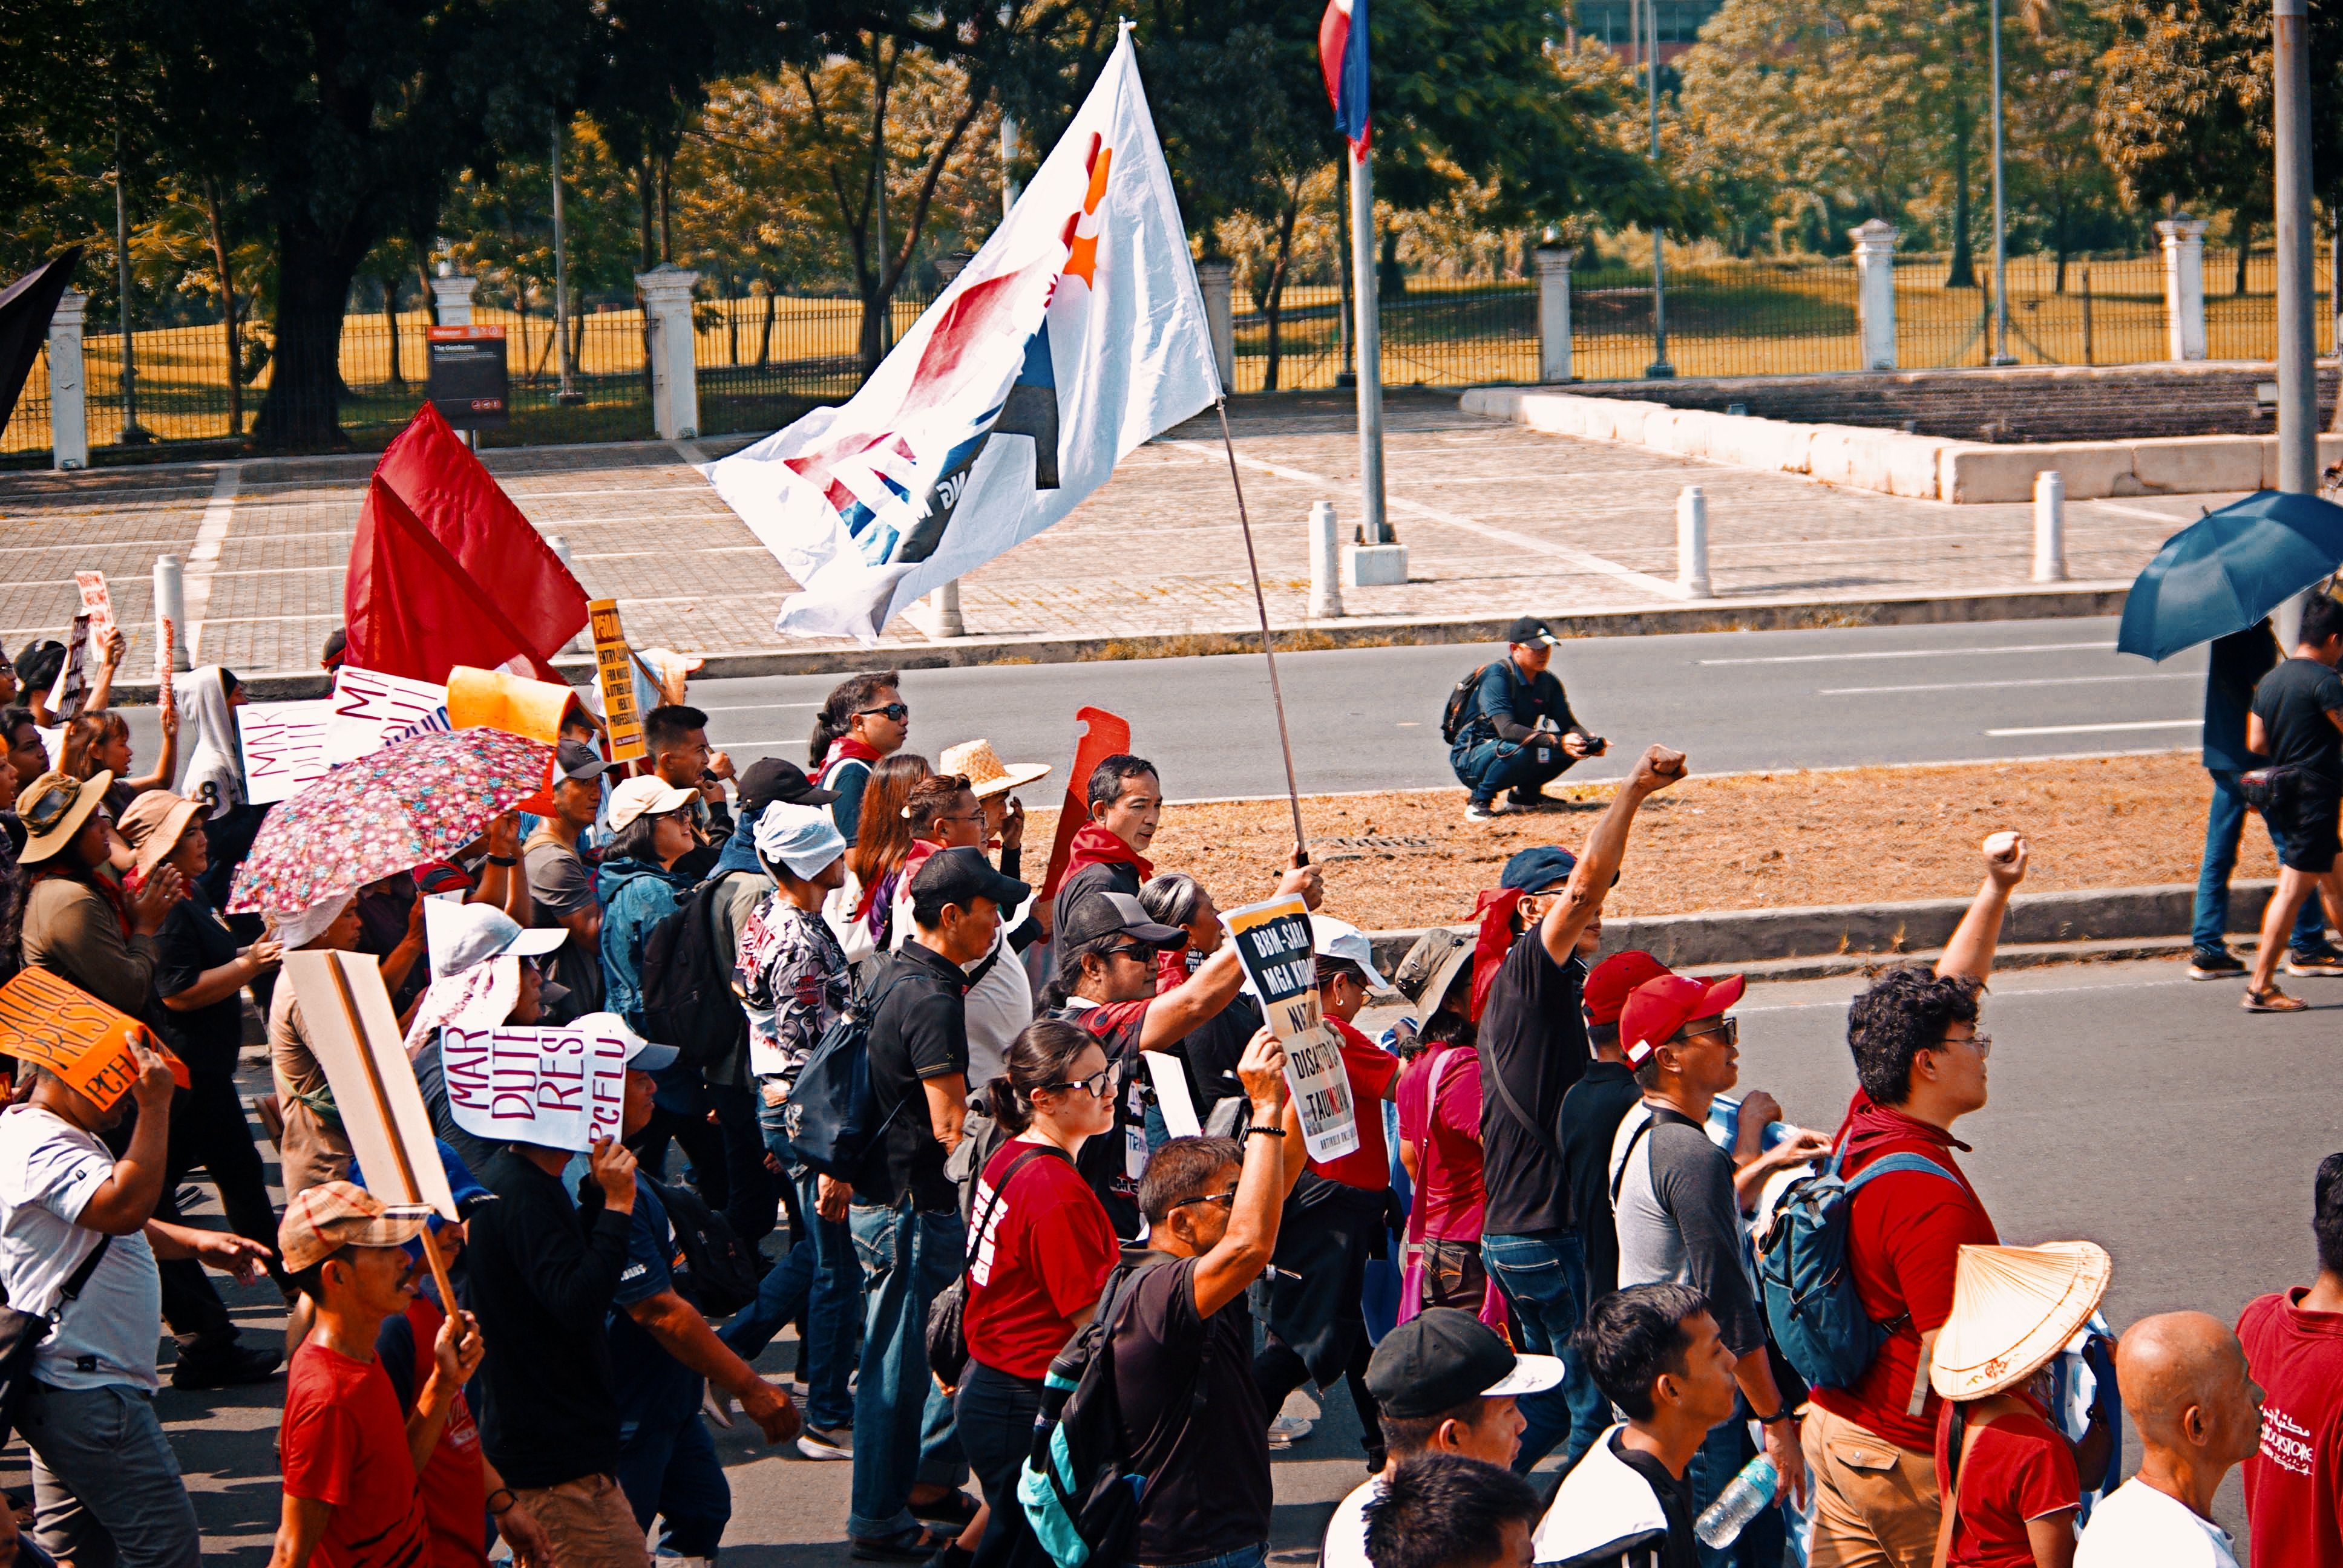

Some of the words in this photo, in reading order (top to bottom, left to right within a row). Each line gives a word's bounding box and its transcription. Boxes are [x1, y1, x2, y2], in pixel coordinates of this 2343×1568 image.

[598, 648, 616, 665] ENTRY
[1251, 921, 1309, 959] BBM-SARA
[1262, 964, 1296, 995] MGA
[445, 1027, 490, 1109] MAR
[491, 1028, 539, 1120] DUTE
